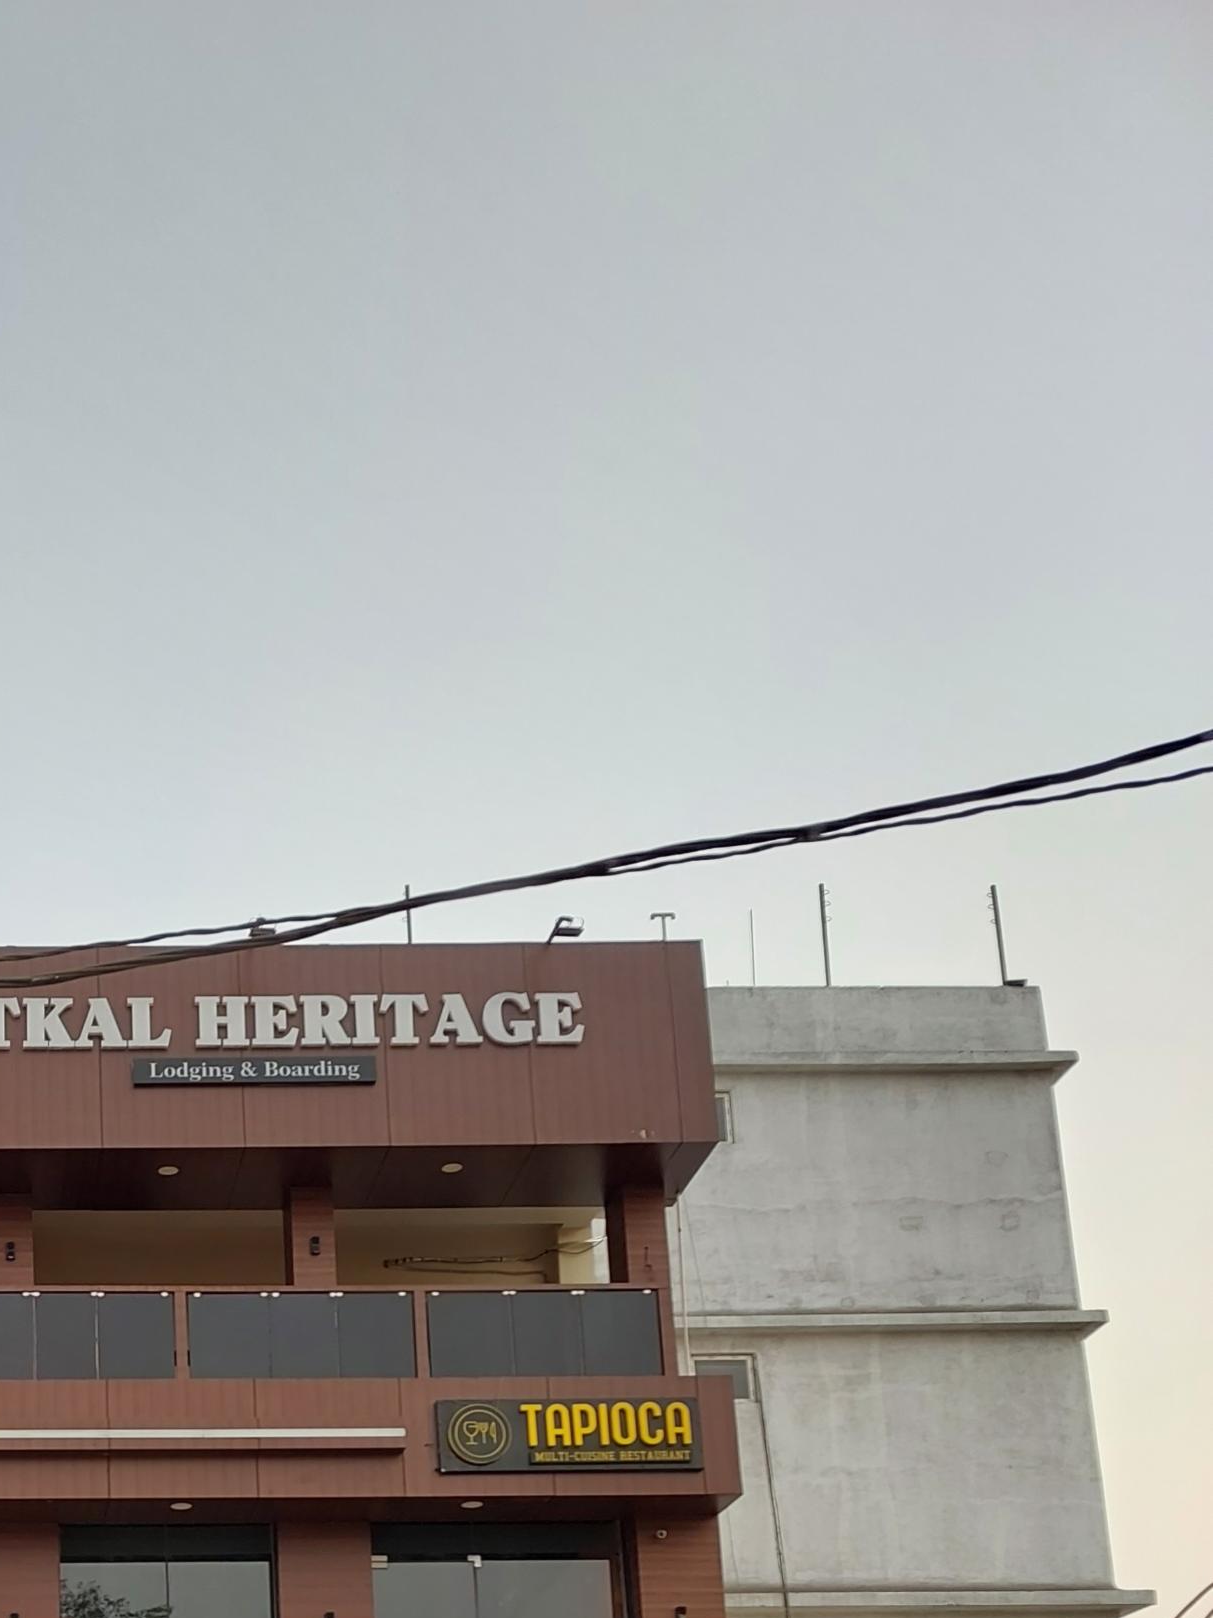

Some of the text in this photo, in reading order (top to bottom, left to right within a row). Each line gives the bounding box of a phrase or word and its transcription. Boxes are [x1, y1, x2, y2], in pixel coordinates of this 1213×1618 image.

[193, 991, 585, 1048] HERITAGE
[149, 1060, 360, 1081] Lodging & Boarding
[519, 1401, 693, 1447] TAPIOCA
[534, 1449, 691, 1462] MULTI-CUISINE RESTAURANT
